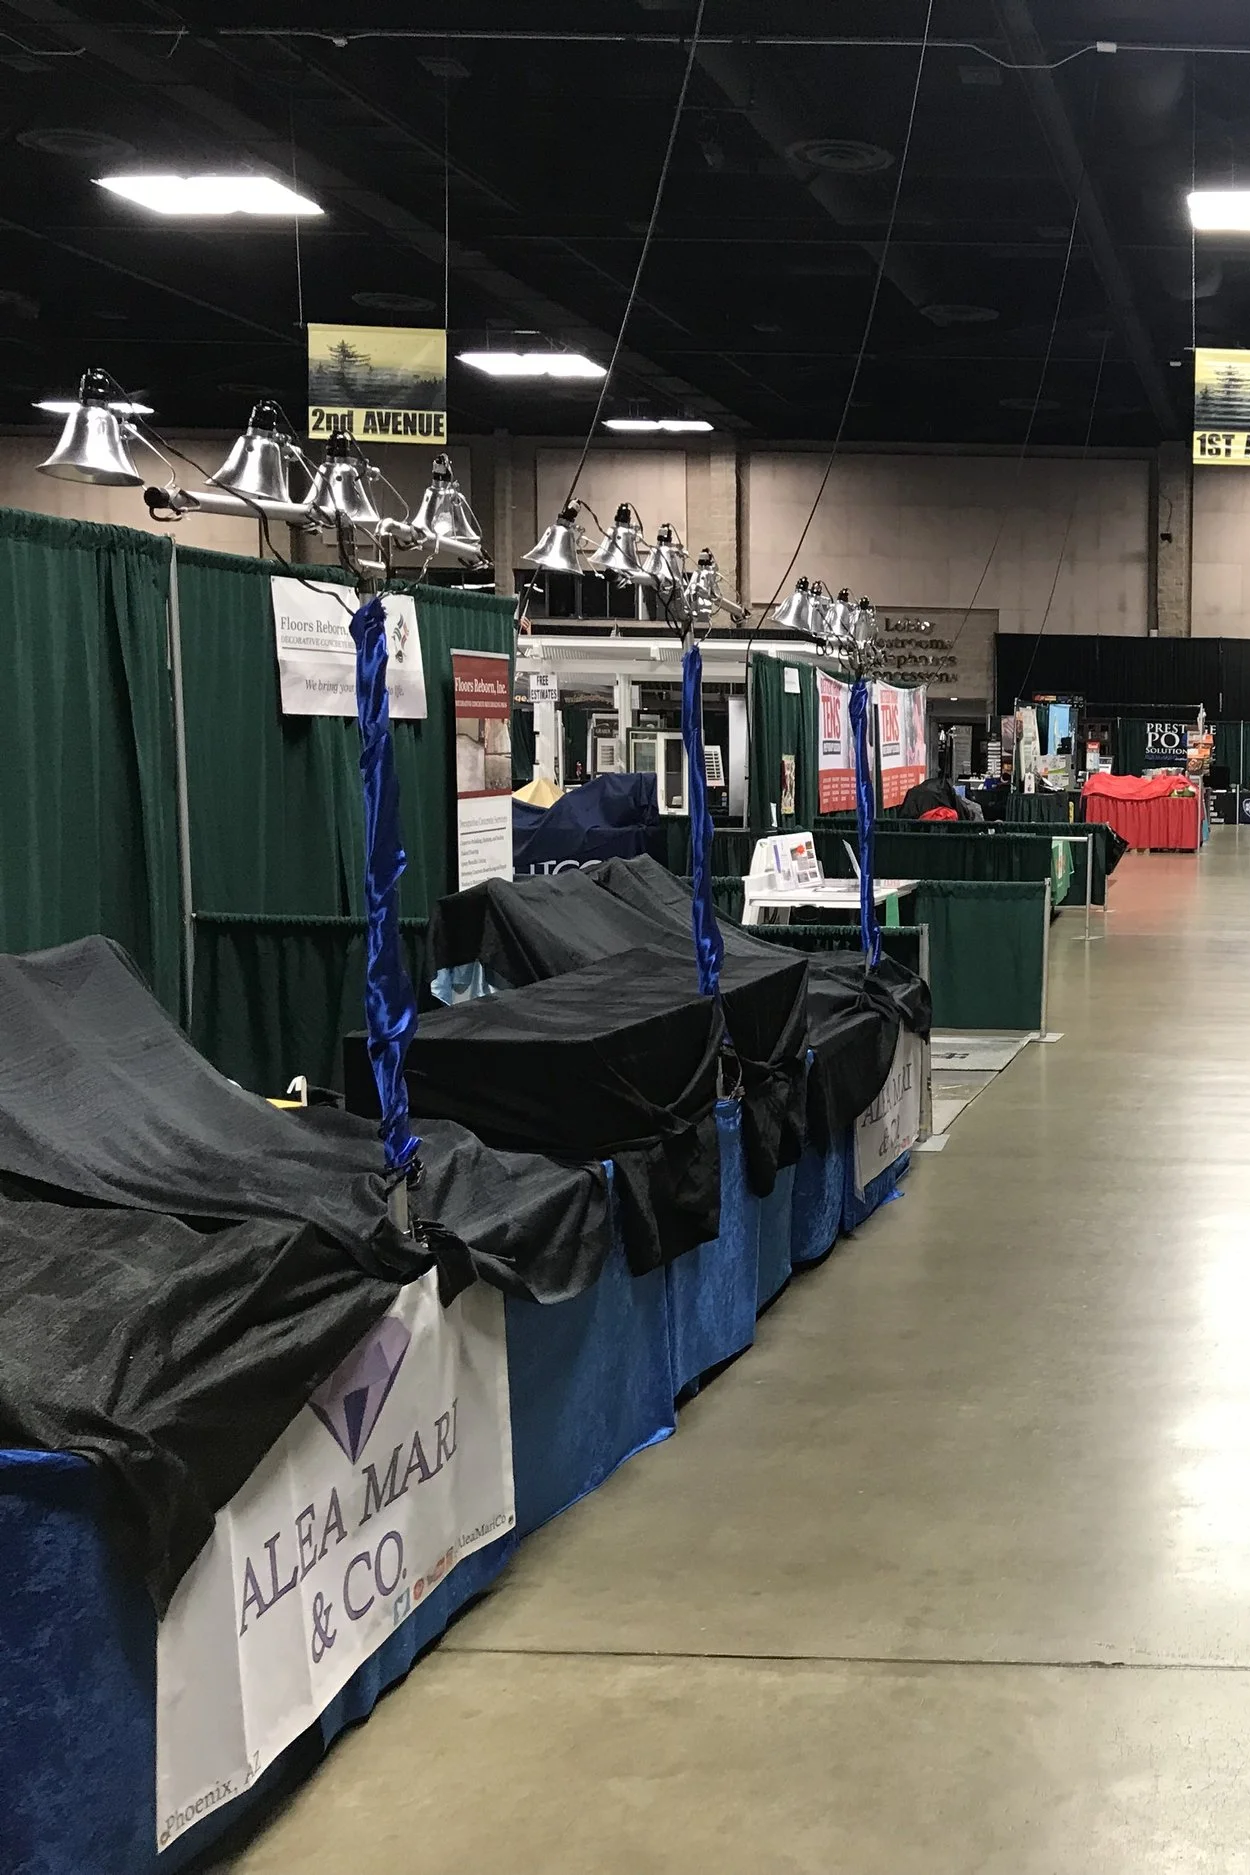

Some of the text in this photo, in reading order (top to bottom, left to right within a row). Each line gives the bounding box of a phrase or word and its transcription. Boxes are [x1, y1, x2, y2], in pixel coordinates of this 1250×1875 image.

[311, 408, 445, 437] 2nd AVENUE
[1196, 433, 1235, 457] 1ST
[280, 616, 314, 632] Floors
[875, 637, 953, 649] estrooms
[536, 675, 549, 686] FREE
[871, 670, 958, 682] oncessions
[305, 680, 317, 690] We
[318, 680, 338, 694] bring
[454, 677, 474, 692] Floors
[496, 680, 507, 694] Inc.
[531, 689, 557, 699] ESTIMATES
[821, 695, 841, 739] TENS
[881, 704, 900, 742] TENS
[1146, 723, 1217, 735] PRESTE
[239, 1397, 459, 1638] ALEA MARI
[311, 1530, 407, 1664] & CO.
[244, 1750, 261, 1785] AZ
